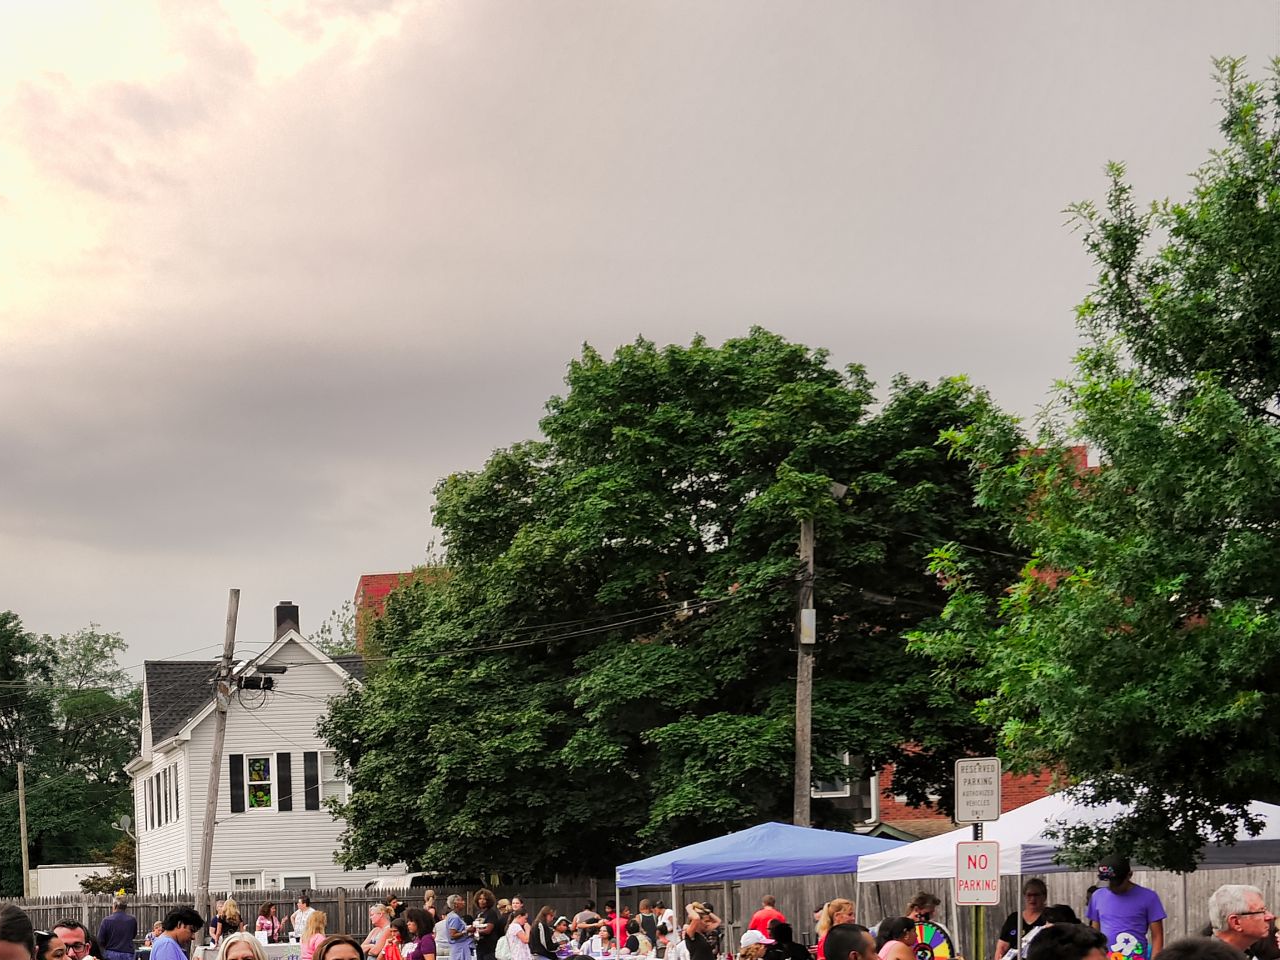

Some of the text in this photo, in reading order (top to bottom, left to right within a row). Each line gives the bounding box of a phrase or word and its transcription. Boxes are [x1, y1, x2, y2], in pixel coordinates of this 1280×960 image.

[960, 764, 995, 773] RESERVED
[963, 776, 993, 786] PARKING
[967, 854, 988, 870] NO
[958, 879, 997, 891] PARKING
